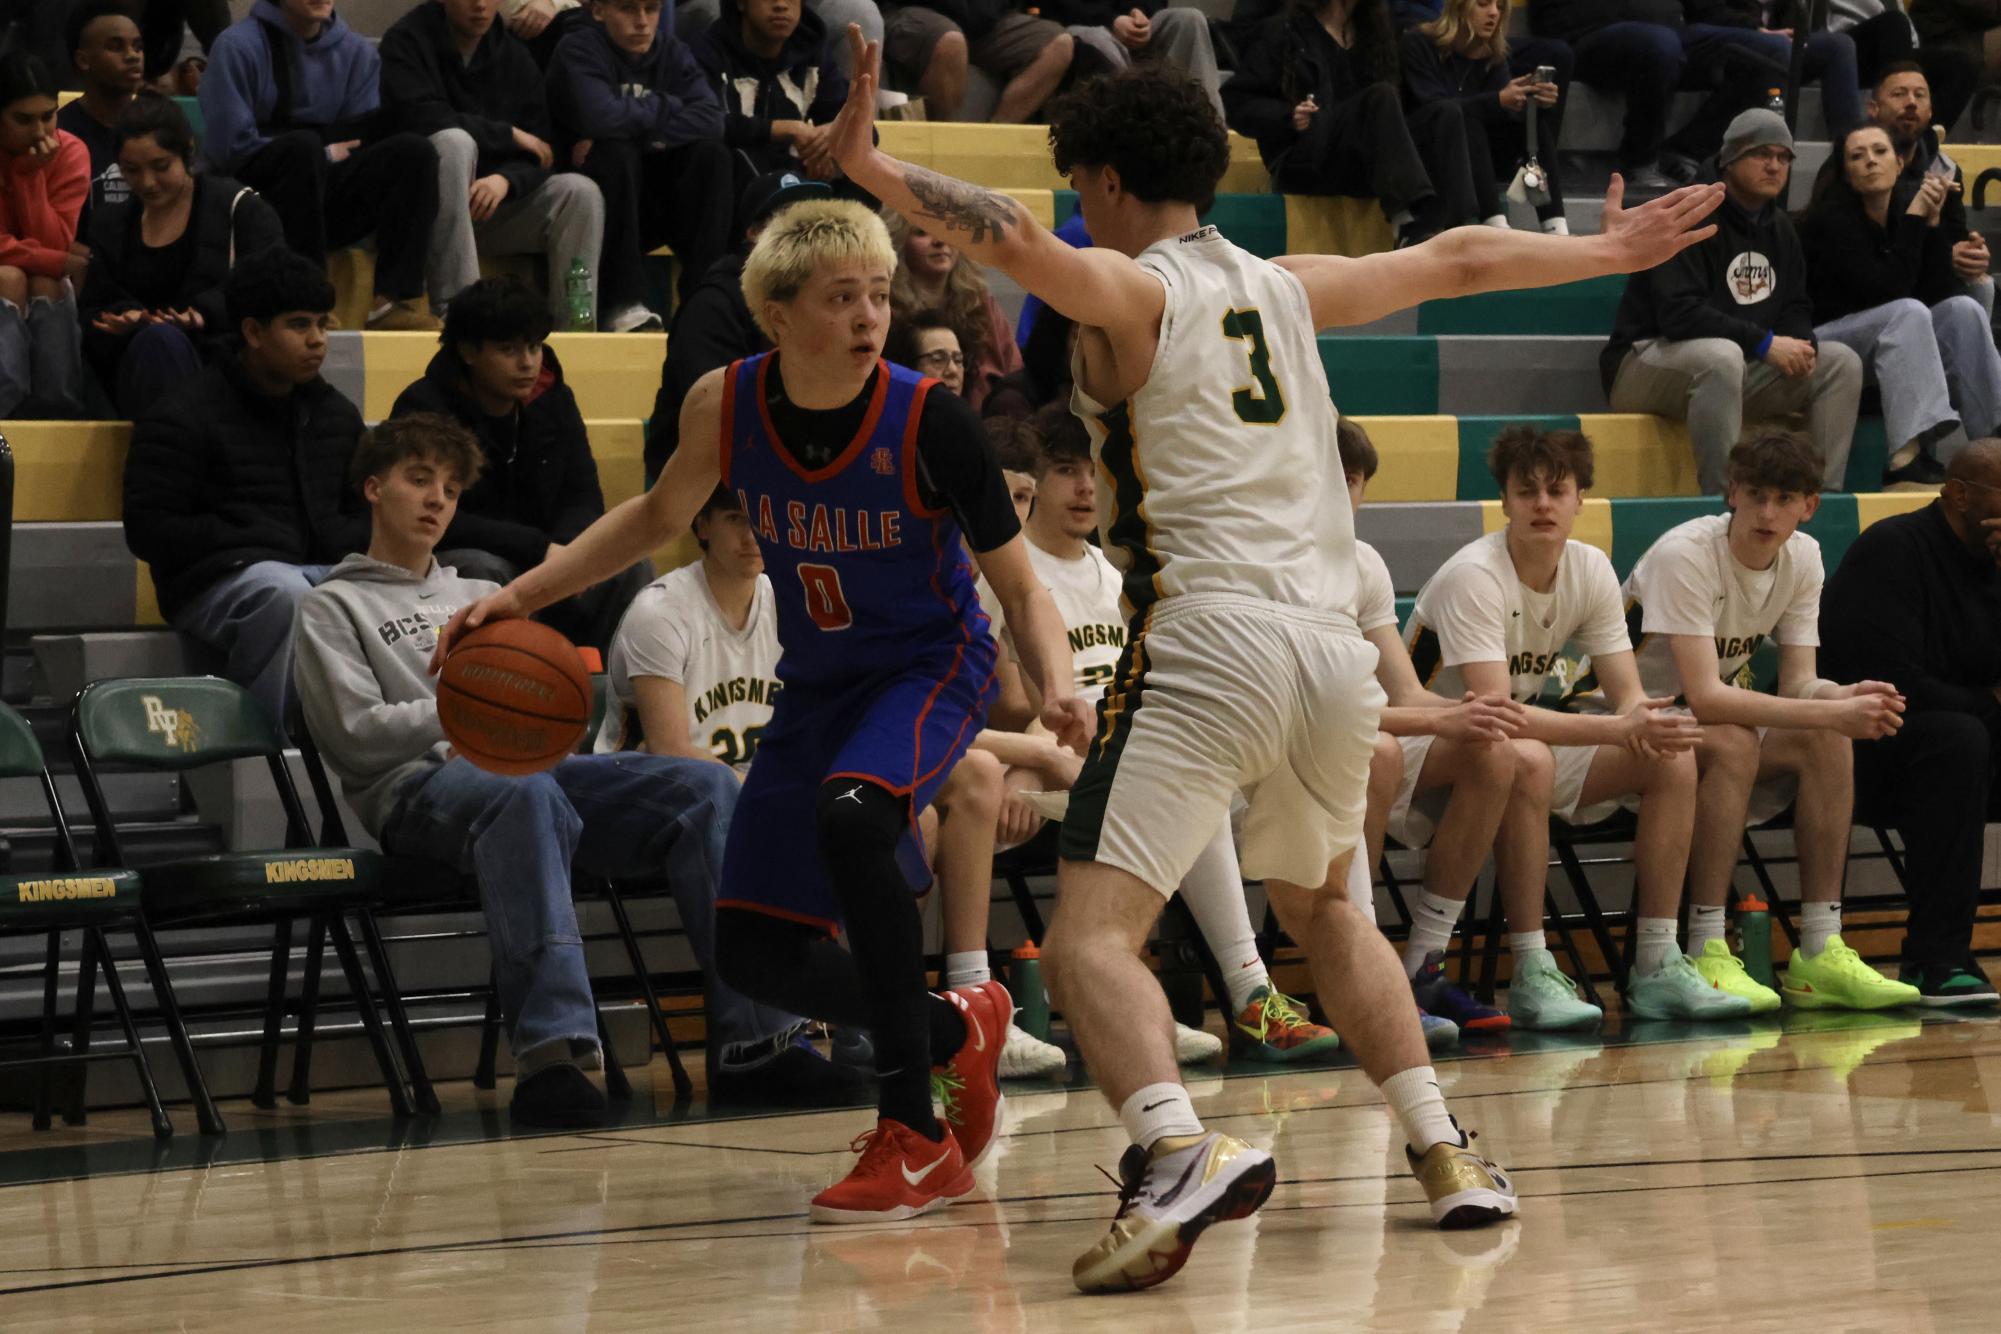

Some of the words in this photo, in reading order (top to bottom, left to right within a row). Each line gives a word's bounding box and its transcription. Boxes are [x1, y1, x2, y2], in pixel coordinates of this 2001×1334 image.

[1179, 229, 1207, 244] NIKE
[1221, 305, 1287, 425] 3
[787, 500, 902, 553] SALLE
[797, 562, 853, 632] 0
[142, 696, 178, 745] RP
[18, 877, 116, 902] KINGSMEN
[265, 858, 355, 884] KINGSMEN
